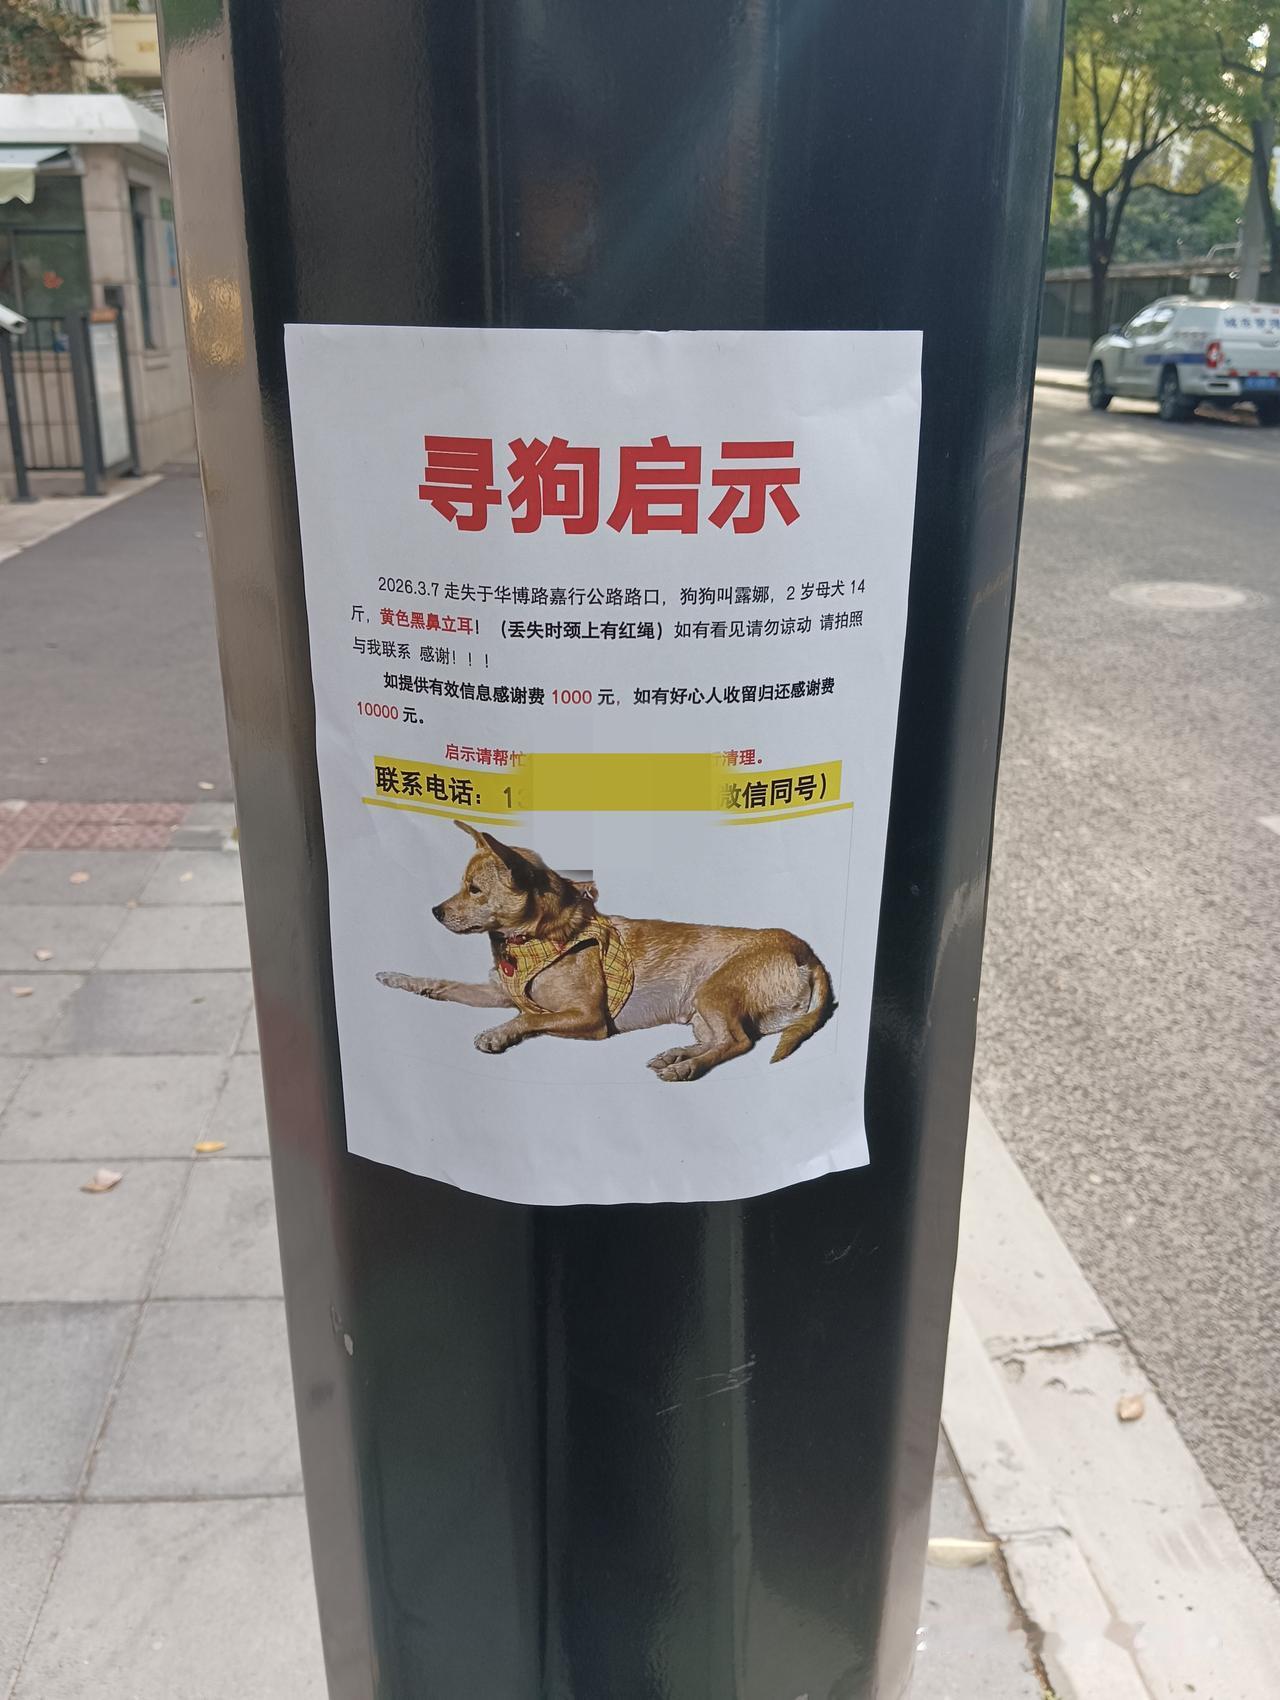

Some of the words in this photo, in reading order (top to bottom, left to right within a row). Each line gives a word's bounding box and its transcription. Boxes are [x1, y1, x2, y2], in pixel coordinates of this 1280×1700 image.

[419, 435, 801, 534] 寻狗启示
[378, 576, 440, 597] 2026.3.7
[786, 586, 796, 601] 2
[800, 579, 846, 601] 岁母犬
[850, 579, 866, 594] 14
[820, 610, 864, 632] 请拍照
[352, 636, 412, 660] 与我联系
[419, 645, 490, 668] 感谢！！！
[383, 672, 545, 706] 如提供有效信息感谢费
[551, 690, 593, 705] 1000
[356, 701, 399, 720] 10000
[402, 707, 426, 724] 元。
[375, 766, 481, 806] 联系电话：
